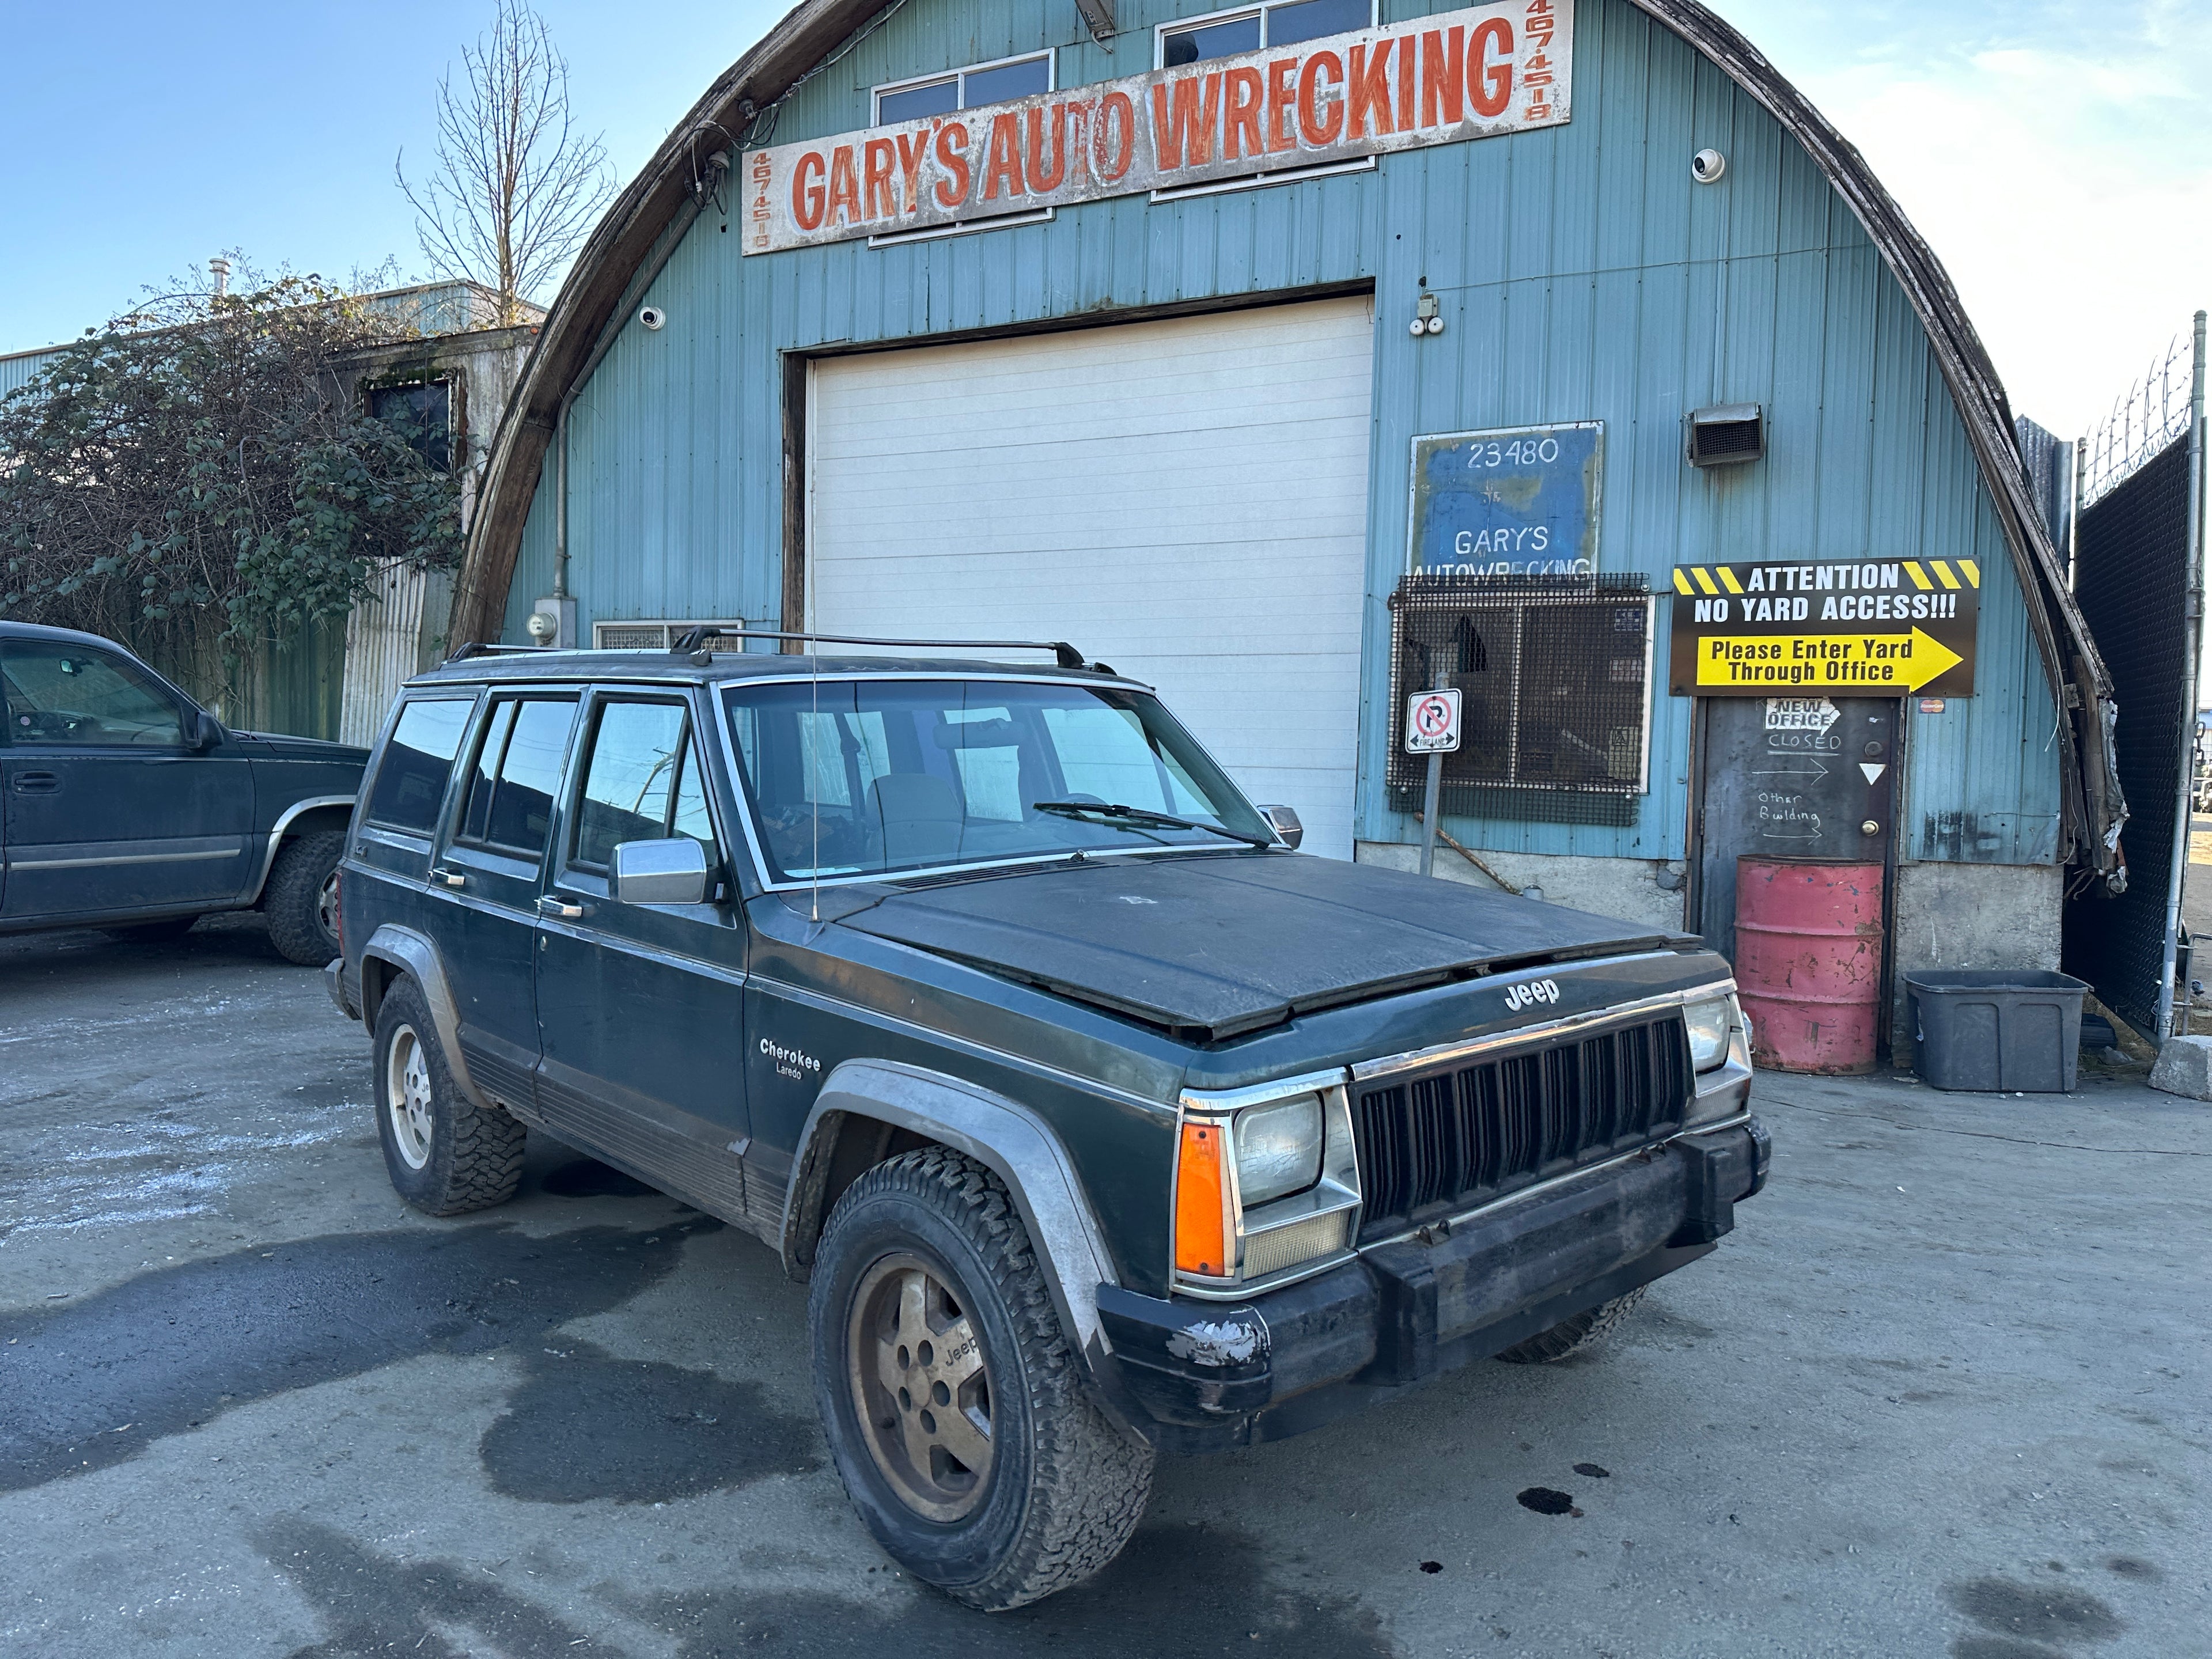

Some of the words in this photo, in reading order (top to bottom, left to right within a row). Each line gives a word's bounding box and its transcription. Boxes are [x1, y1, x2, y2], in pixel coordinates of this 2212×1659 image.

[791, 118, 970, 232] GARY'S
[984, 91, 1135, 200] AUTO
[1152, 17, 1514, 172] WRECKING
[1467, 438, 1559, 469] 23480
[1455, 526, 1548, 555] GARY'S
[1747, 563, 1899, 592] ATTENTION
[1694, 598, 1729, 623] NO
[1741, 596, 1809, 622] YARD
[1820, 593, 1957, 620] ACCESS!!!
[1711, 639, 1782, 660] Please
[1792, 639, 1853, 659] Enter
[1862, 638, 1913, 658] Yard
[1728, 661, 1815, 684] Through
[1825, 660, 1894, 681] Office
[1768, 713, 1831, 726] OFFICE
[1777, 700, 1821, 713] NEW
[1419, 738, 1430, 747] FIRE
[1768, 733, 1841, 749] CLOSED
[1760, 806, 1820, 828] Building
[1505, 979, 1560, 1012] Jeep
[760, 1038, 821, 1071] Cherokee
[776, 1062, 802, 1080] Laredo
[945, 1336, 977, 1368] Jeep
